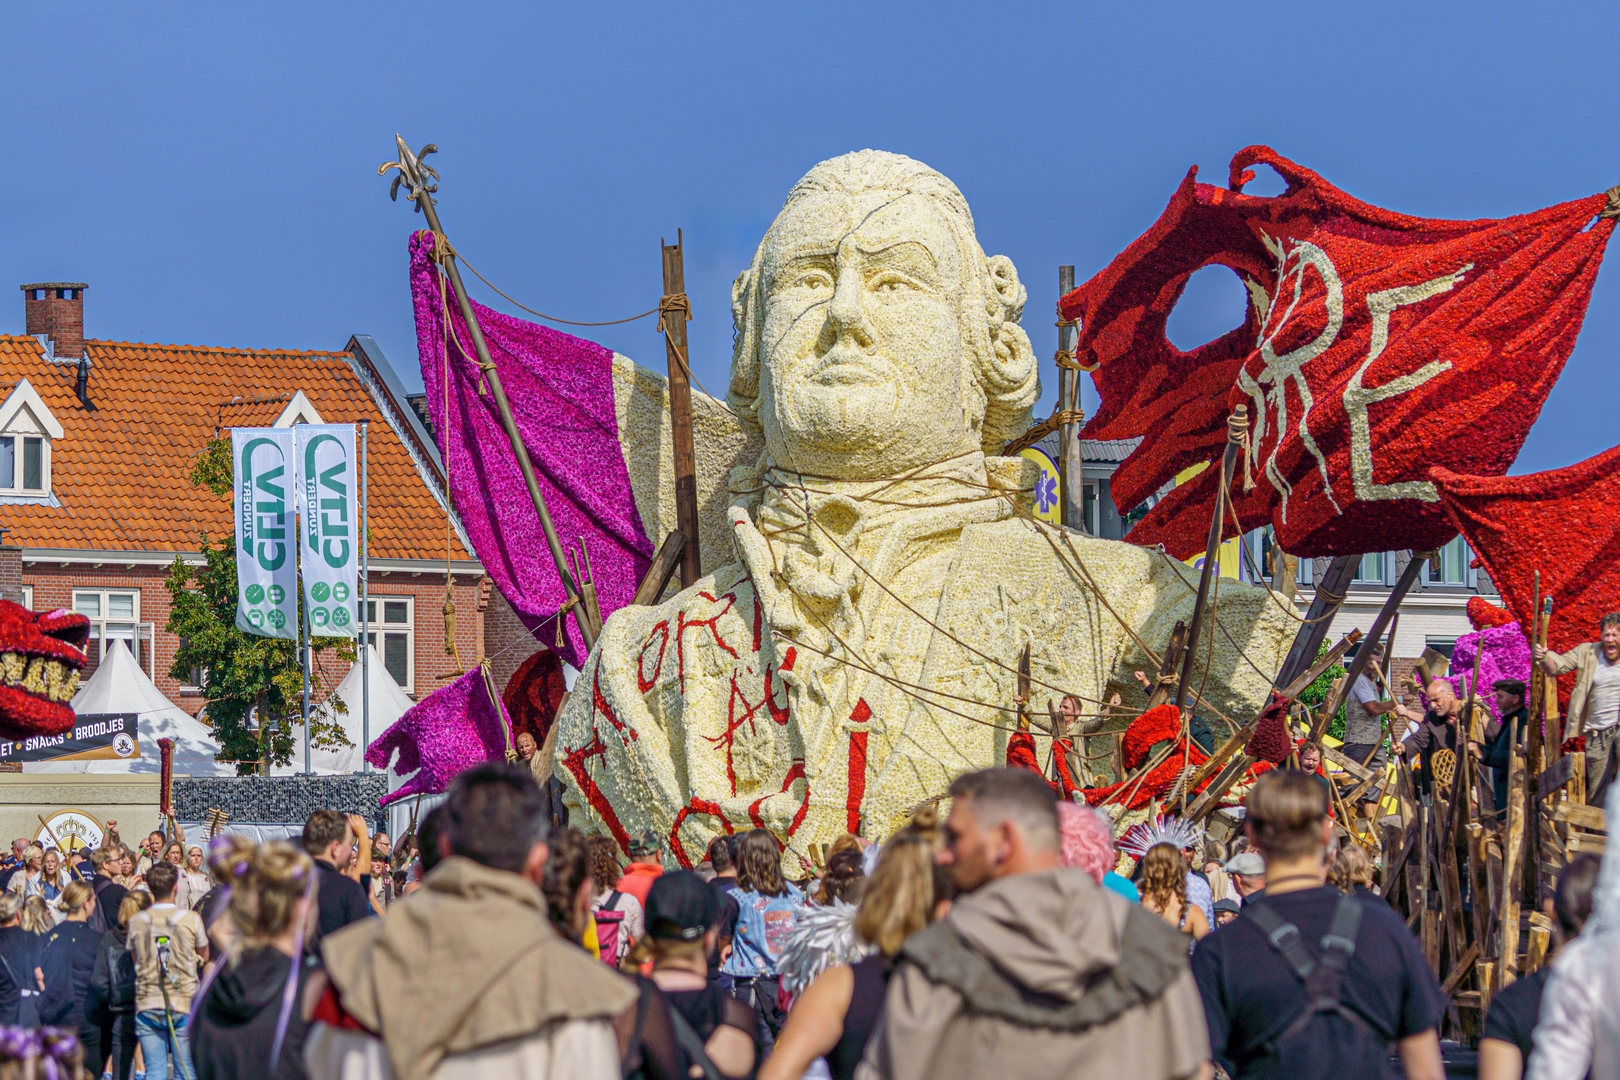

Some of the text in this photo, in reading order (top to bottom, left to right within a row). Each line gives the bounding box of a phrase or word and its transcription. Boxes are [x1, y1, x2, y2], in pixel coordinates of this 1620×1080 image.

[0, 718, 124, 757] ET SNACKS BROODJES
